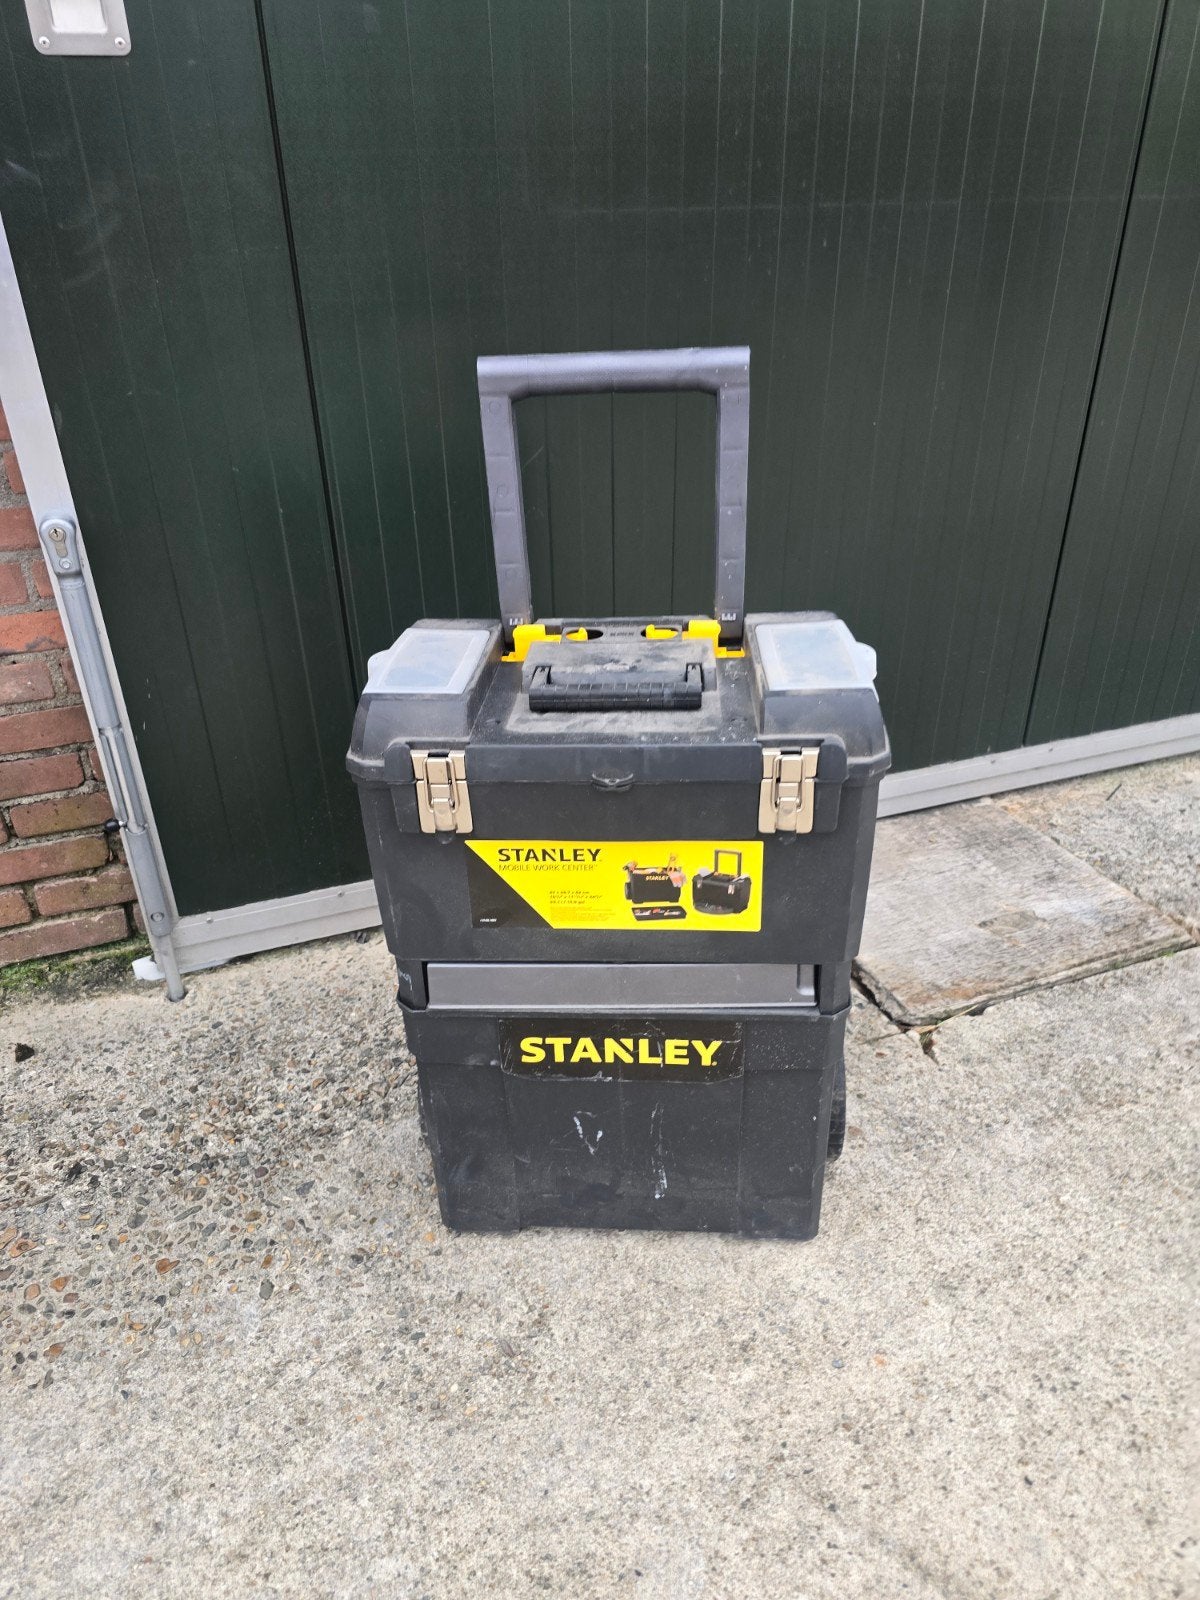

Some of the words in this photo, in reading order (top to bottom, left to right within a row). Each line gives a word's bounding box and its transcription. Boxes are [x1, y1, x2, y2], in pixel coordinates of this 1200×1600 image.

[497, 848, 602, 862] STANLEY
[499, 864, 530, 872] MOBILE
[534, 864, 560, 872] WORK
[519, 1036, 722, 1067] STANLEY
